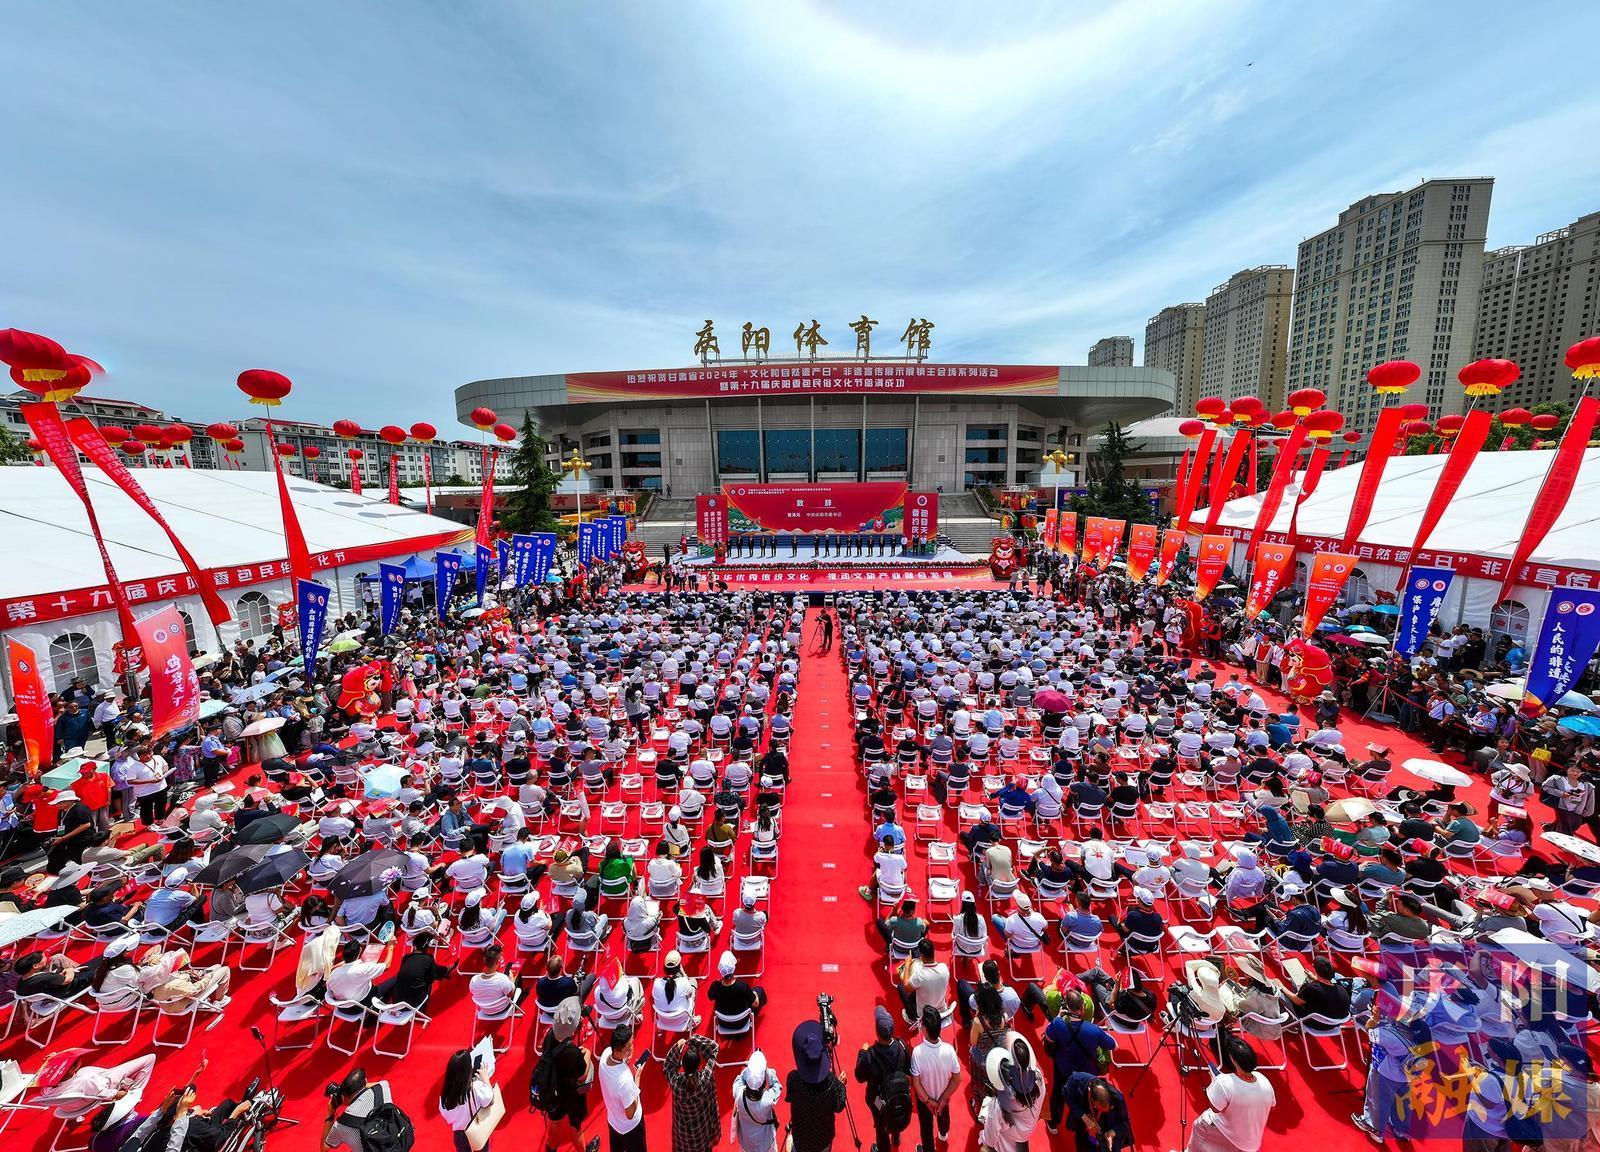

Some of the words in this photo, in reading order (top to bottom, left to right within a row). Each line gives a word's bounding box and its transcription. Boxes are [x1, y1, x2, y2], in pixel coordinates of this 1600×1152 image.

[694, 315, 935, 355] 庆阳体育馆
[720, 378, 905, 391] 暨第十九届庆阳香包民俗文化节圆满成功
[920, 509, 928, 538] 包容天
[6, 551, 346, 620] 第十九届庆香包民俗化节
[1262, 569, 1279, 601] 包容天下
[1548, 622, 1565, 679] 人民的非遗
